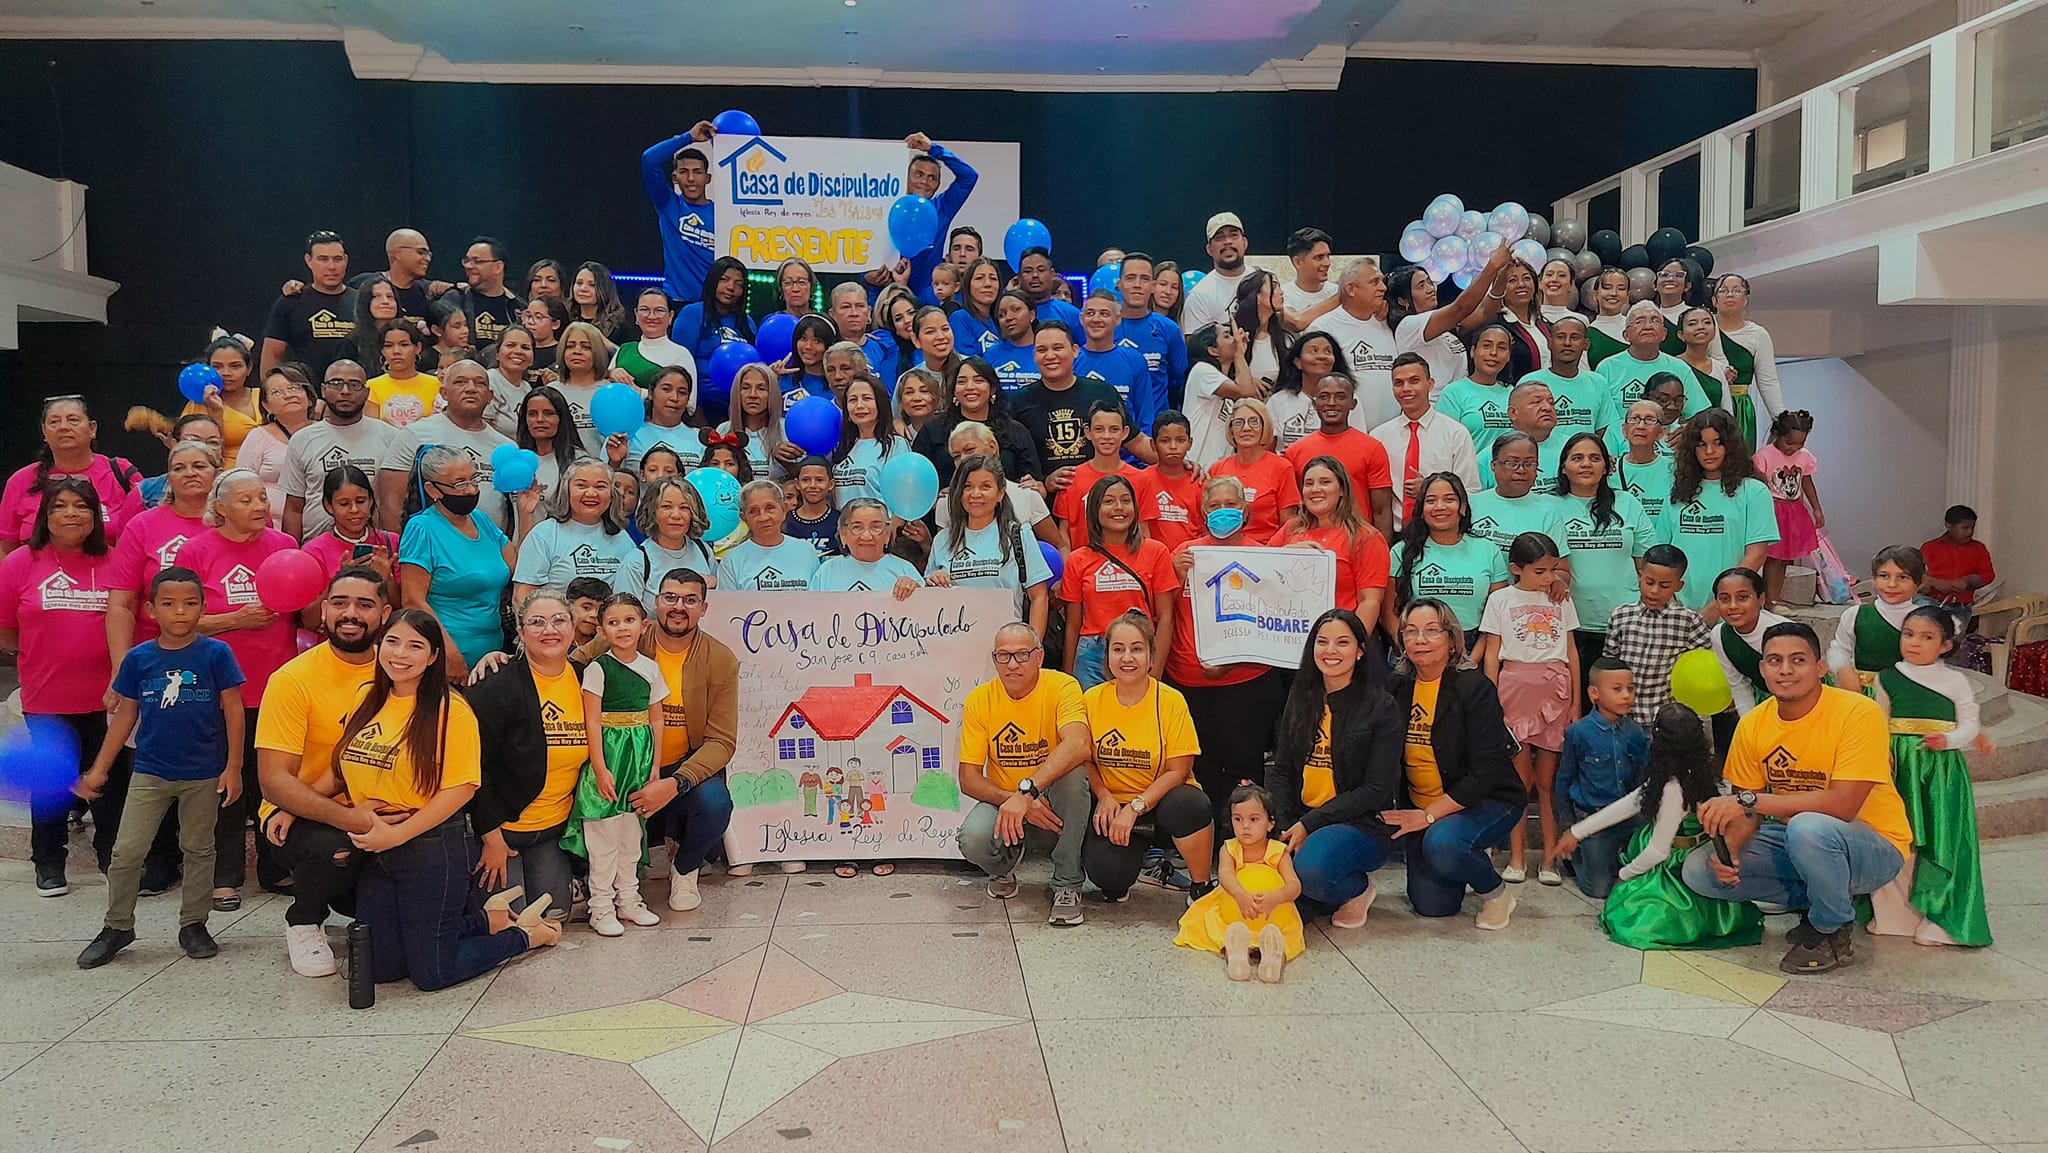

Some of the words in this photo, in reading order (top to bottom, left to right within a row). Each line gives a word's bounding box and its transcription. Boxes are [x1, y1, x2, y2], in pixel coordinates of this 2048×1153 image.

[739, 171, 779, 196] Casa
[784, 171, 805, 196] de
[808, 172, 900, 198] Discipulado
[740, 207, 761, 217] Iglesia
[764, 208, 777, 217] Rey
[781, 208, 790, 216] de
[730, 225, 873, 265] PRESENTE
[391, 409, 417, 418] LOVE
[1055, 422, 1075, 441] 15
[1222, 593, 1245, 611] Casa
[1257, 597, 1310, 618] Discipulado
[730, 610, 822, 653] Casa
[827, 613, 851, 649] de
[855, 605, 978, 653] Discipulado
[1257, 615, 1310, 634] BOBARE
[796, 650, 828, 670] San
[545, 722, 555, 731] asa
[1000, 742, 1014, 753] Casa
[759, 819, 833, 853] Iglesia
[851, 824, 889, 851] Rey
[897, 818, 917, 844] de
